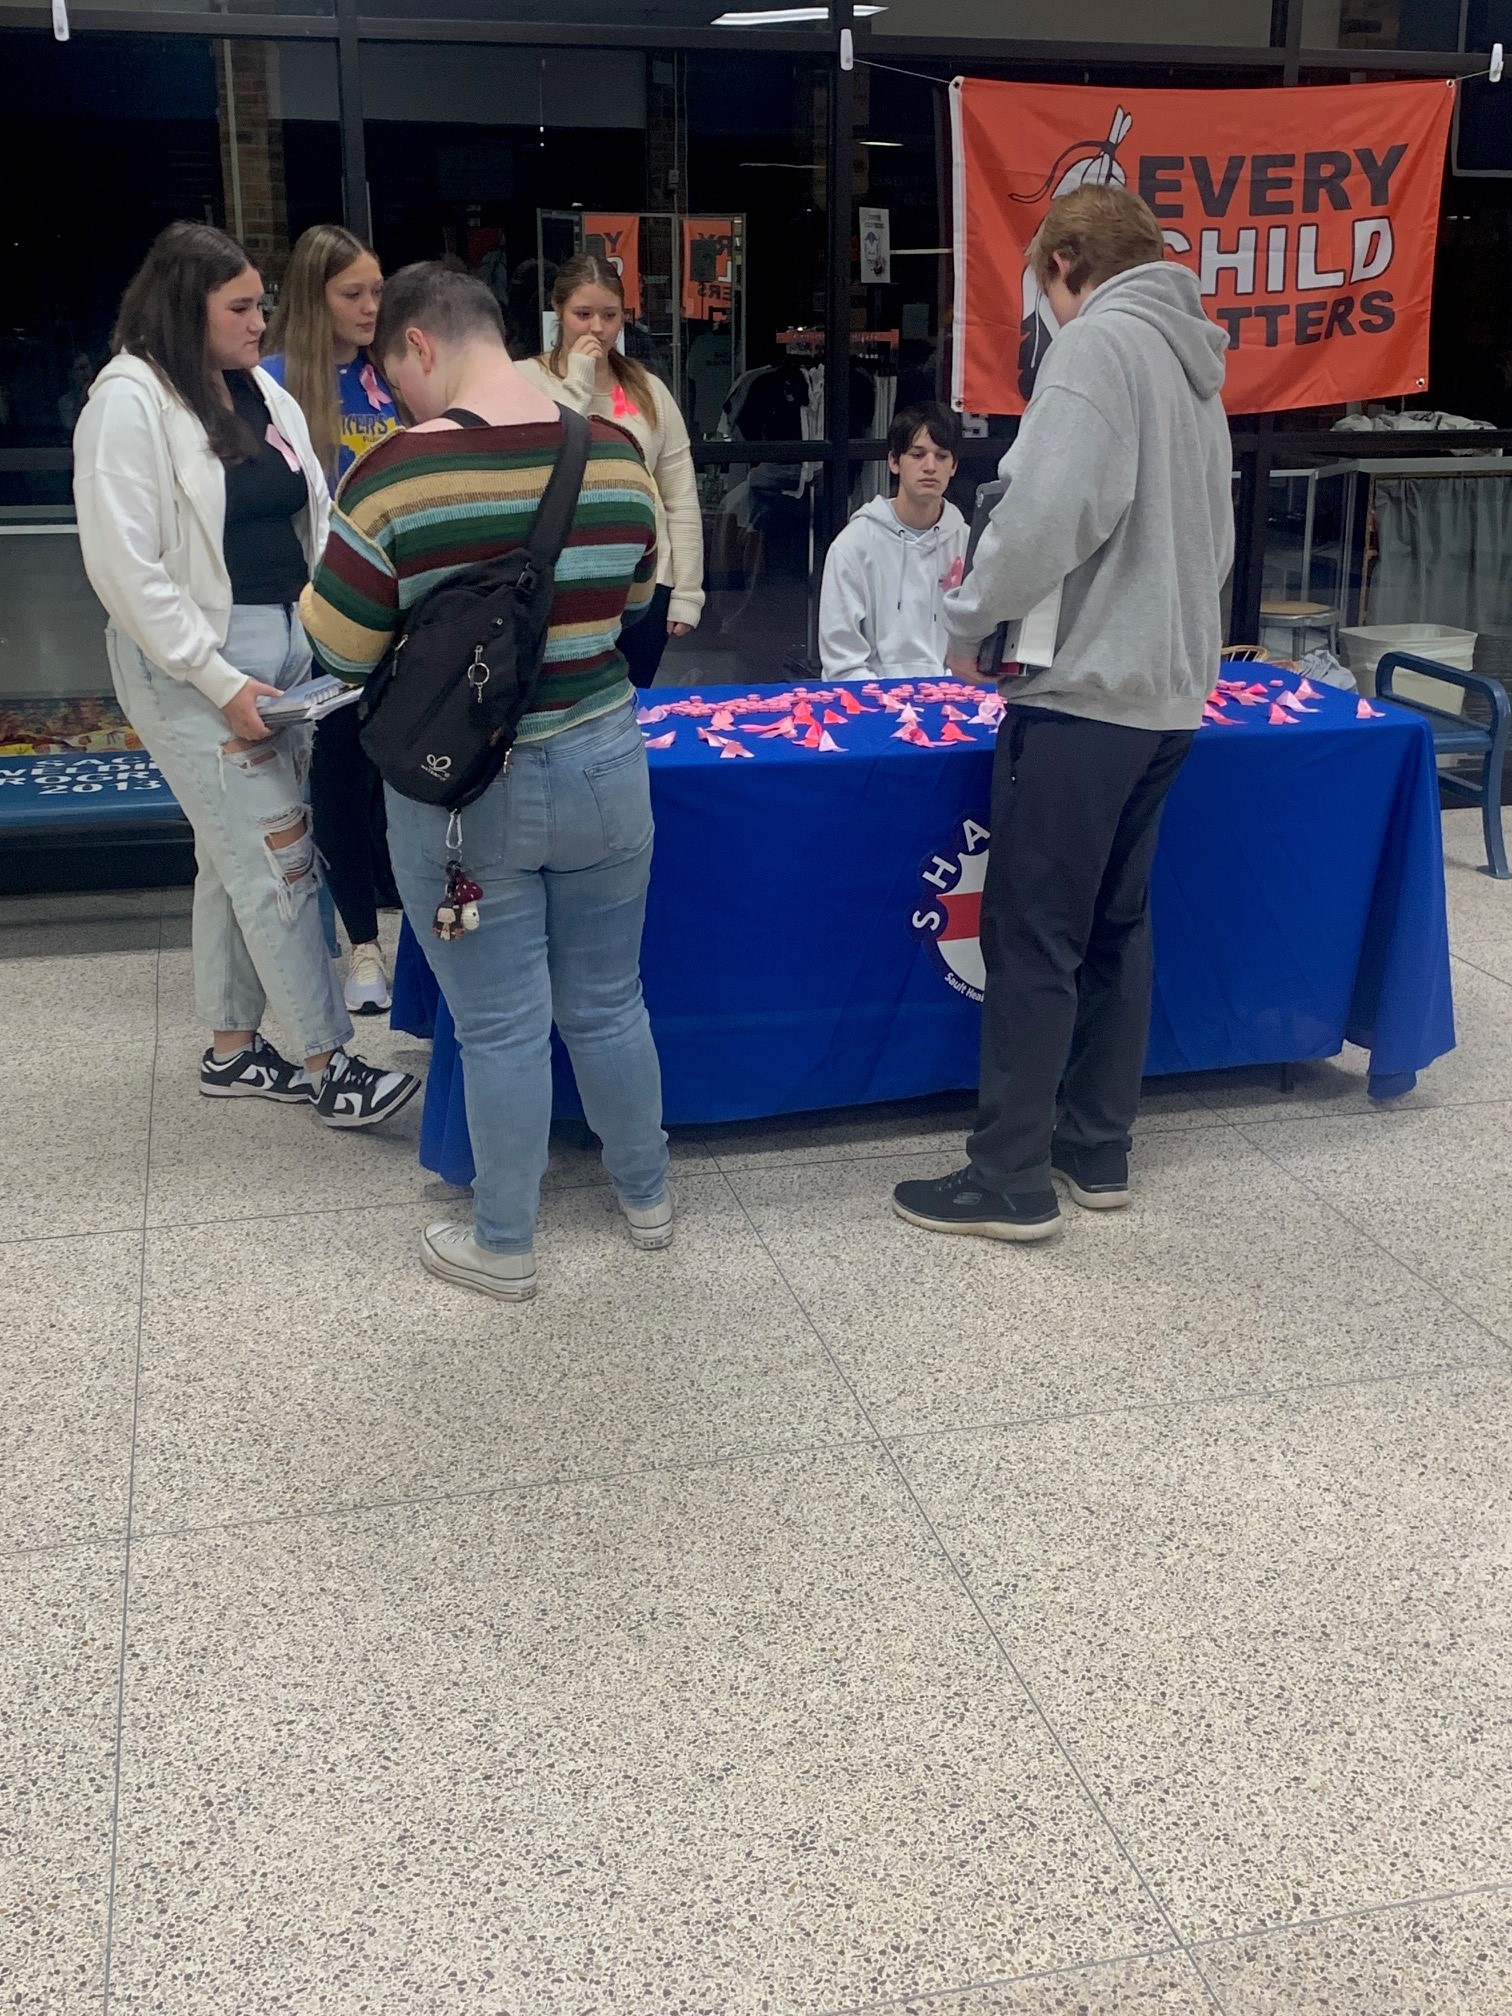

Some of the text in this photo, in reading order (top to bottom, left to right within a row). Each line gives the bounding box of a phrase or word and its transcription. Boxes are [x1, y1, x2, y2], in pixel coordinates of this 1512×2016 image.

[1138, 143, 1408, 218] EVERY
[1204, 291, 1395, 350] TTERS
[34, 756, 155, 767] SAC
[0, 771, 164, 785] ROGR
[38, 780, 161, 795] 2013
[944, 972, 967, 994] Sault
